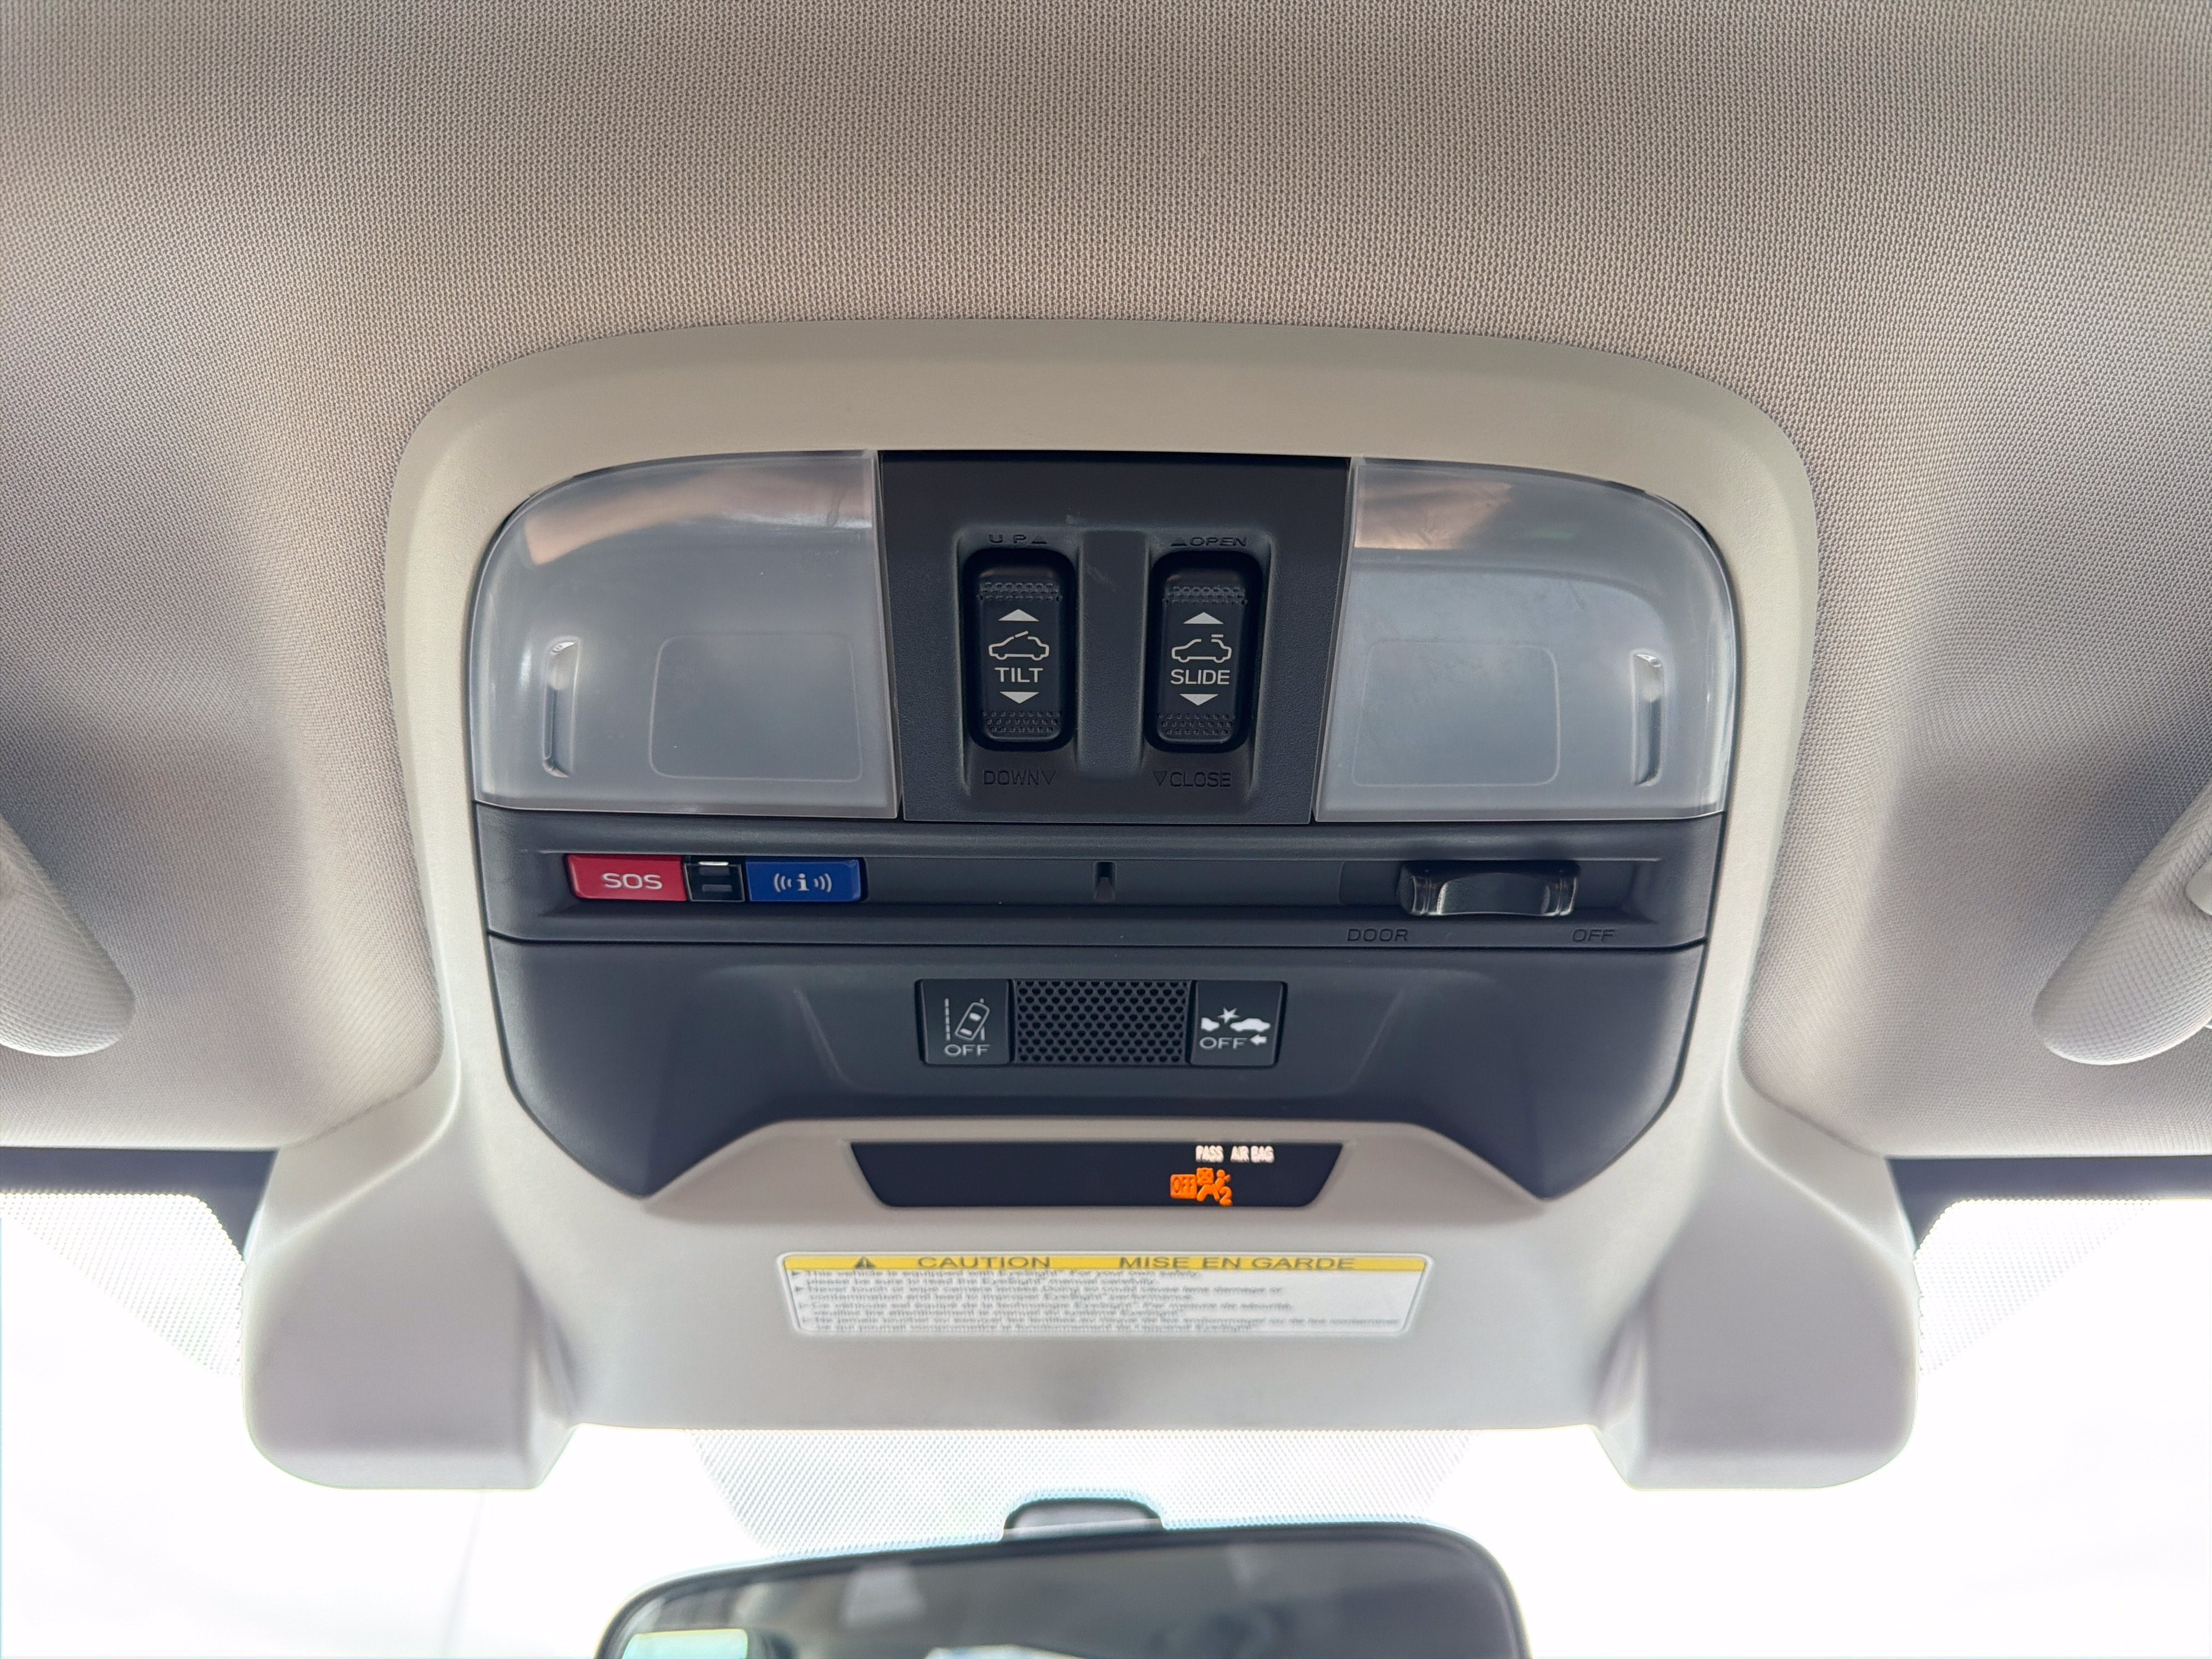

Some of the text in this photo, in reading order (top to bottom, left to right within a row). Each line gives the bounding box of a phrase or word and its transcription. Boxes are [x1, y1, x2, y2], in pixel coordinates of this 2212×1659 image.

[989, 534, 1027, 544] UP
[1189, 536, 1248, 547] OPEN
[994, 667, 1043, 683] TILT
[1170, 669, 1231, 685] SLIDE
[983, 770, 1040, 786] DOWN
[1170, 771, 1232, 788] CLOSE
[601, 873, 663, 890] SOS
[1346, 928, 1409, 943] DOOR
[1571, 928, 1616, 943] OFF
[944, 1043, 990, 1057] OFF
[1199, 1036, 1248, 1050] OFF
[1195, 1144, 1224, 1163] PASS
[1251, 1146, 1275, 1164] BAG
[918, 1256, 1051, 1269] CAUTION
[1119, 1257, 1356, 1270] MISE EN GARDE
